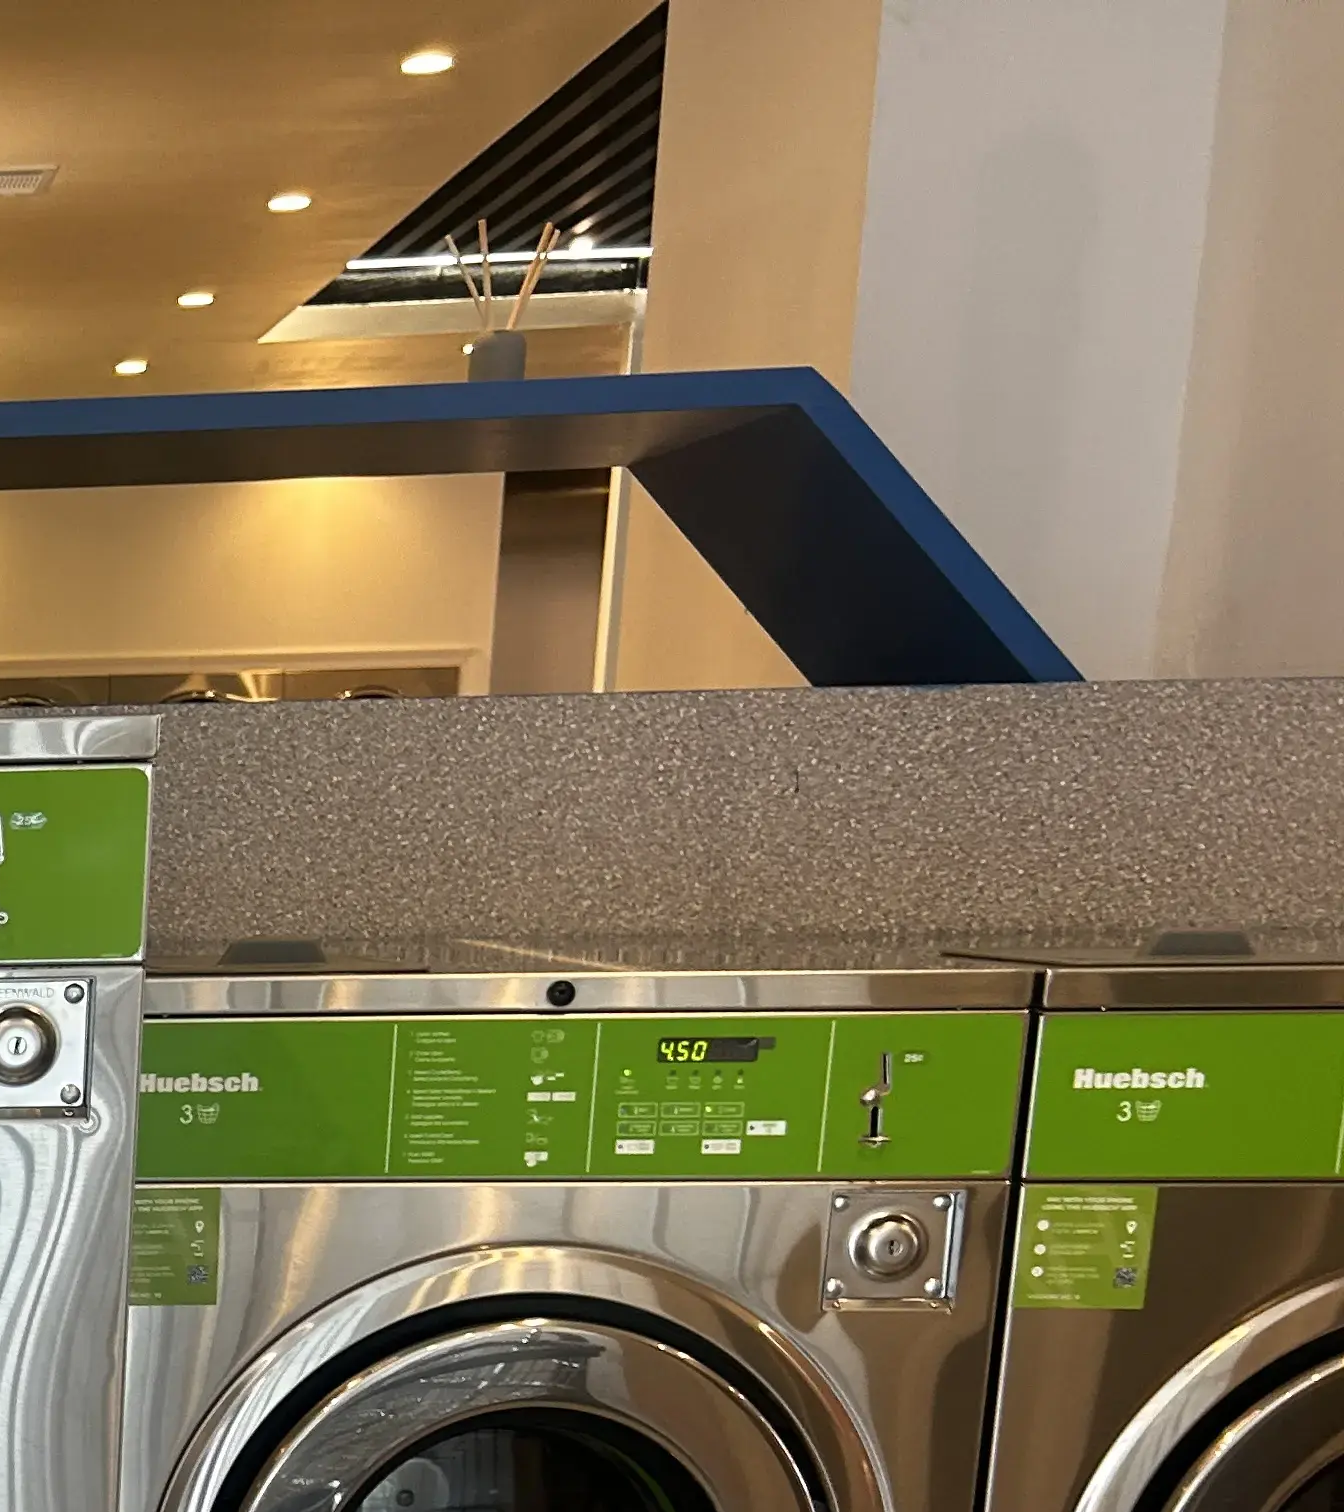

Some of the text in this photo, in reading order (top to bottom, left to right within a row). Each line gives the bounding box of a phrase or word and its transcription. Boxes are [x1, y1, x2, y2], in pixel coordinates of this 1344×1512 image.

[139, 1072, 260, 1093] Huebsch
[1072, 1067, 1206, 1091] Huebsch
[179, 1104, 194, 1125] 3
[1115, 1100, 1133, 1123] 3
